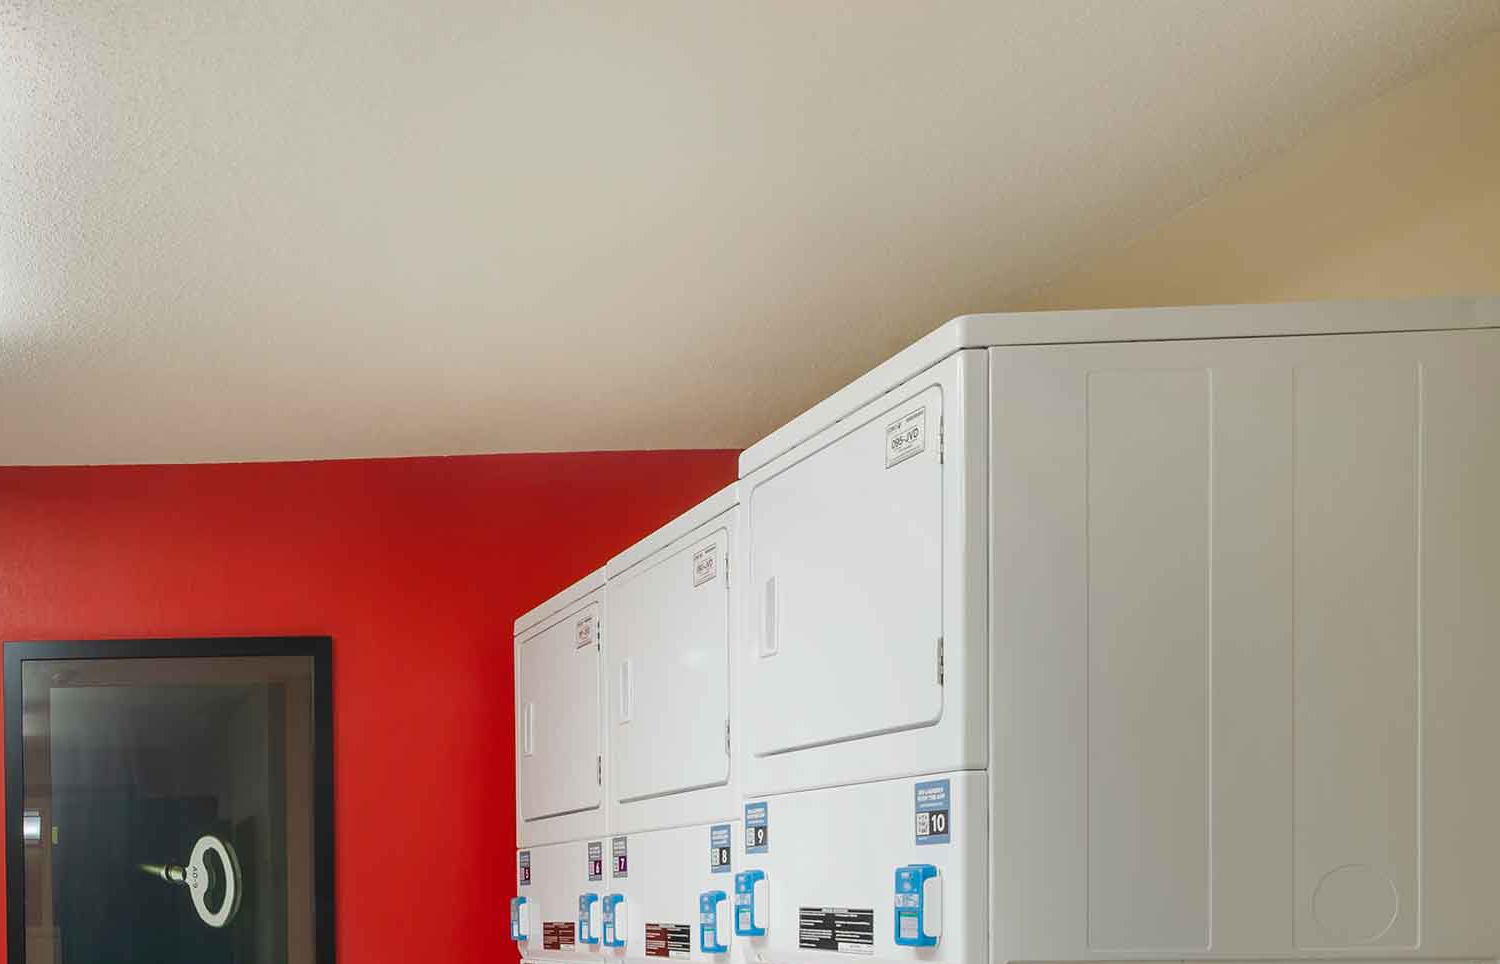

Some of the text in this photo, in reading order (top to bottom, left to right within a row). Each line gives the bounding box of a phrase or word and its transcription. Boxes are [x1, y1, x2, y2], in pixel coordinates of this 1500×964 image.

[931, 813, 945, 832] 10
[757, 828, 764, 844] 9
[620, 857, 626, 870] 7
[721, 849, 728, 864] 8
